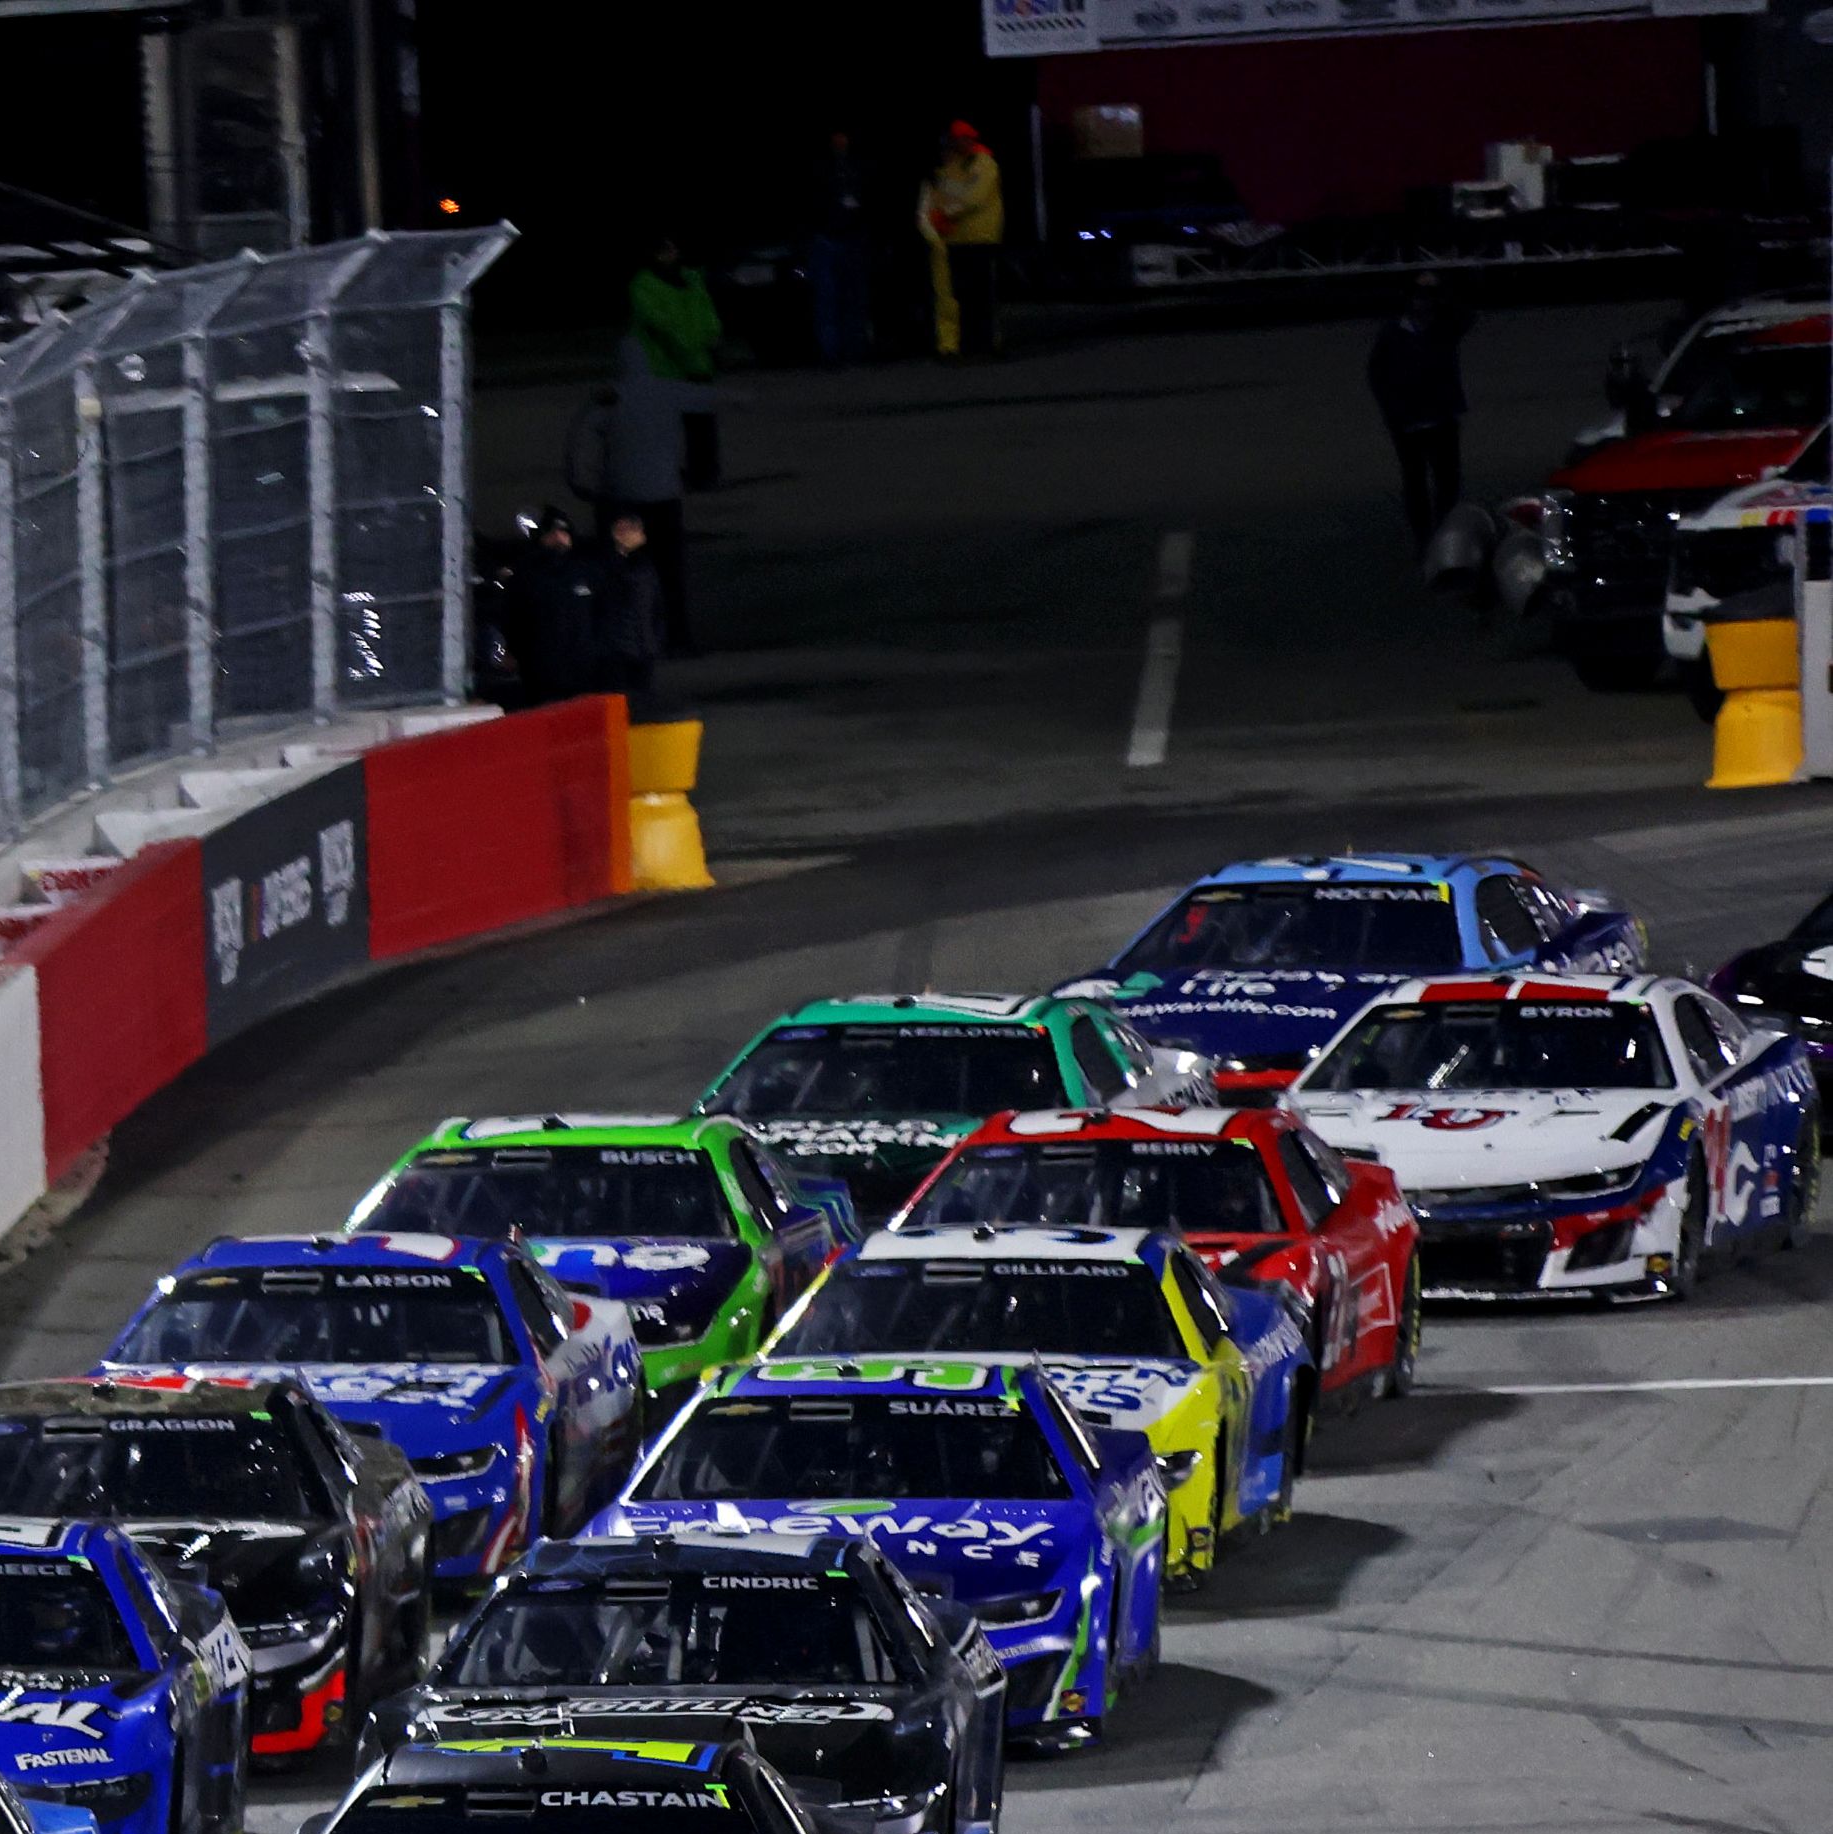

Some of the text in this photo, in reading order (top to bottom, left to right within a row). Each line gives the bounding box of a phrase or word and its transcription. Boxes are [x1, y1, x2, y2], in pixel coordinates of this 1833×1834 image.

[1519, 1005, 1613, 1019] BYRON
[1131, 1142, 1217, 1156] BERRY
[600, 1149, 699, 1166] BUSCH
[992, 1263, 1129, 1278] GILLILAND
[334, 1272, 453, 1290] LARSON
[889, 1398, 1019, 1419] SUÁREZ
[108, 1417, 237, 1433] GRAGSON
[702, 1576, 820, 1591] CINDRIC
[13, 1747, 115, 1771] FASTENAL
[540, 1791, 724, 1809] CHASTAIN
